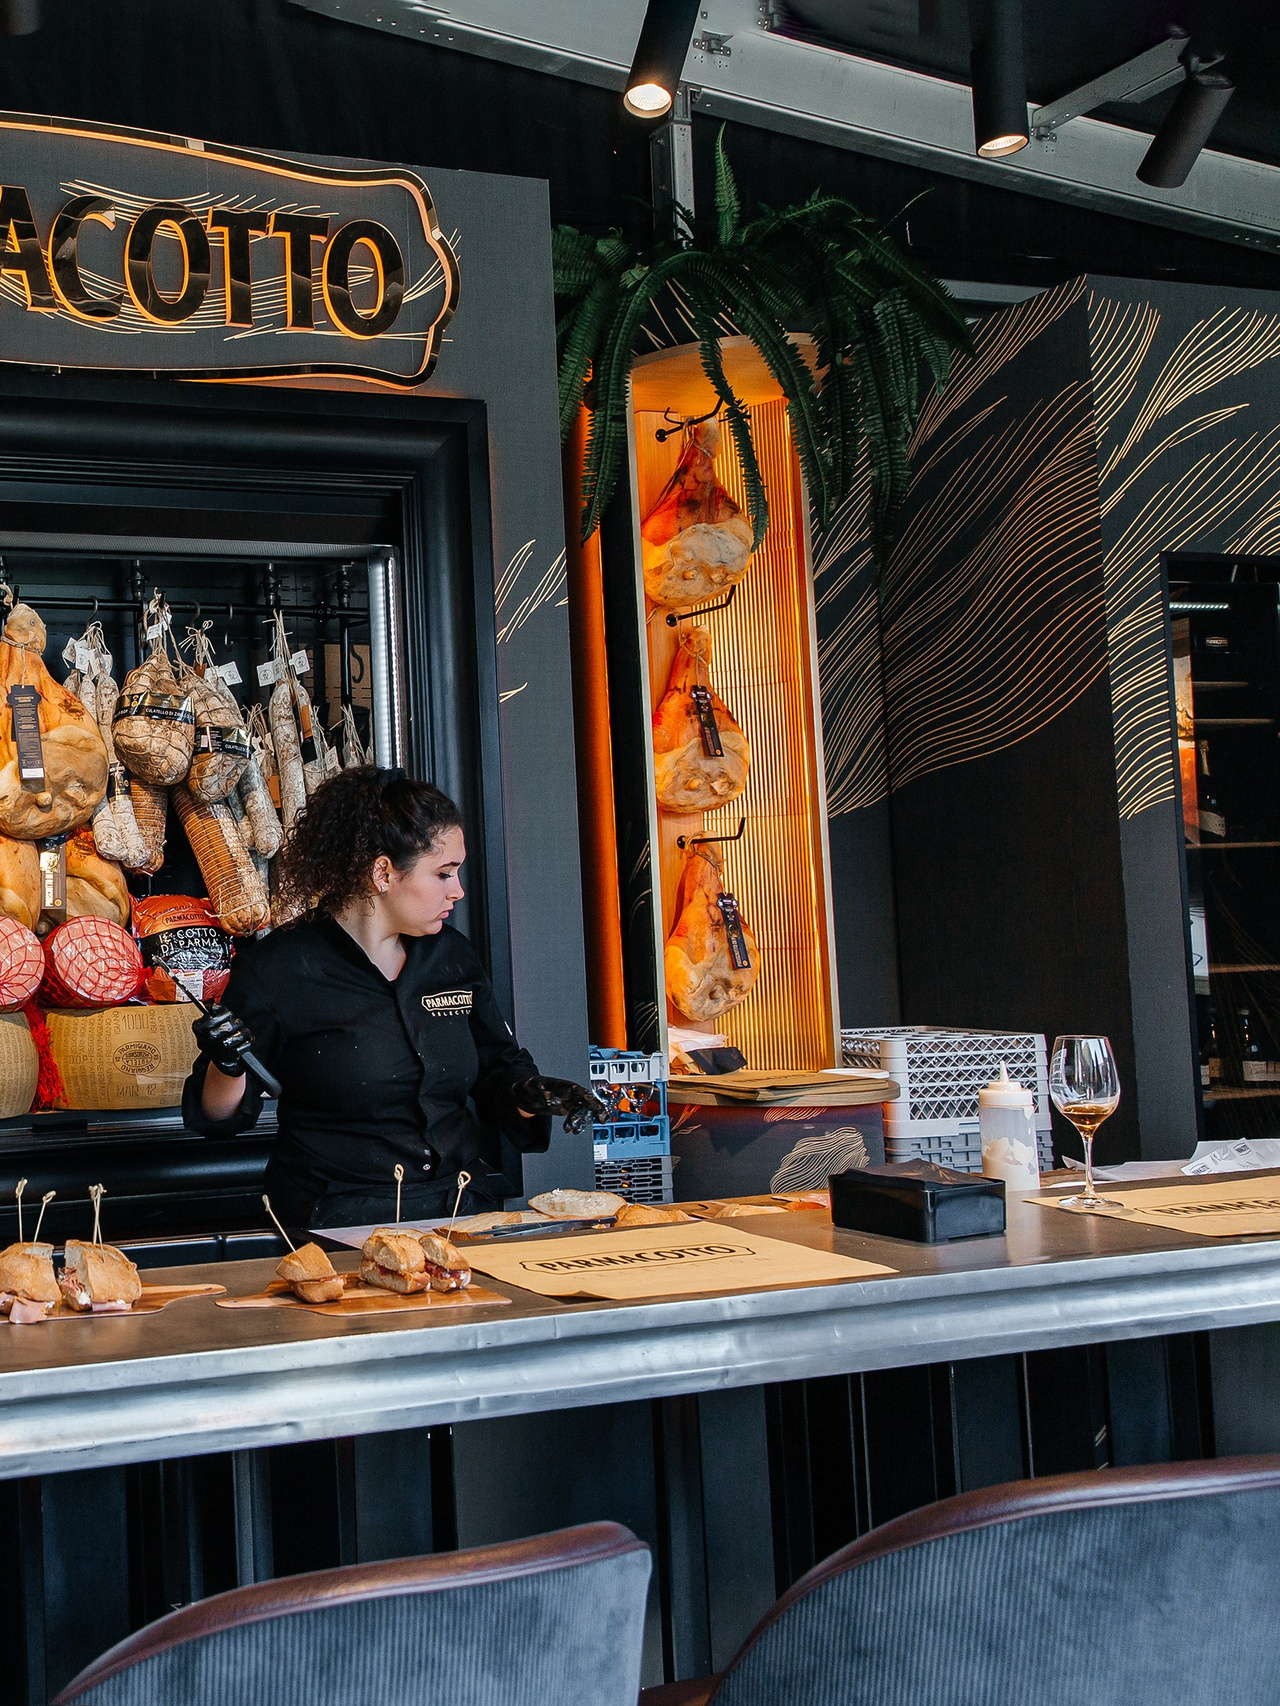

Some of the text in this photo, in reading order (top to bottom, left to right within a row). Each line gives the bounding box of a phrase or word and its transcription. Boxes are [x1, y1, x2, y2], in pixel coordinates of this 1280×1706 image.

[165, 913, 204, 924] PARMACOTTO
[177, 928, 216, 939] COTTO
[179, 938, 219, 948] PARMA
[121, 1014, 149, 1029] 1000
[146, 1084, 156, 1095] 12
[536, 1246, 736, 1271] PARMACOTTO
